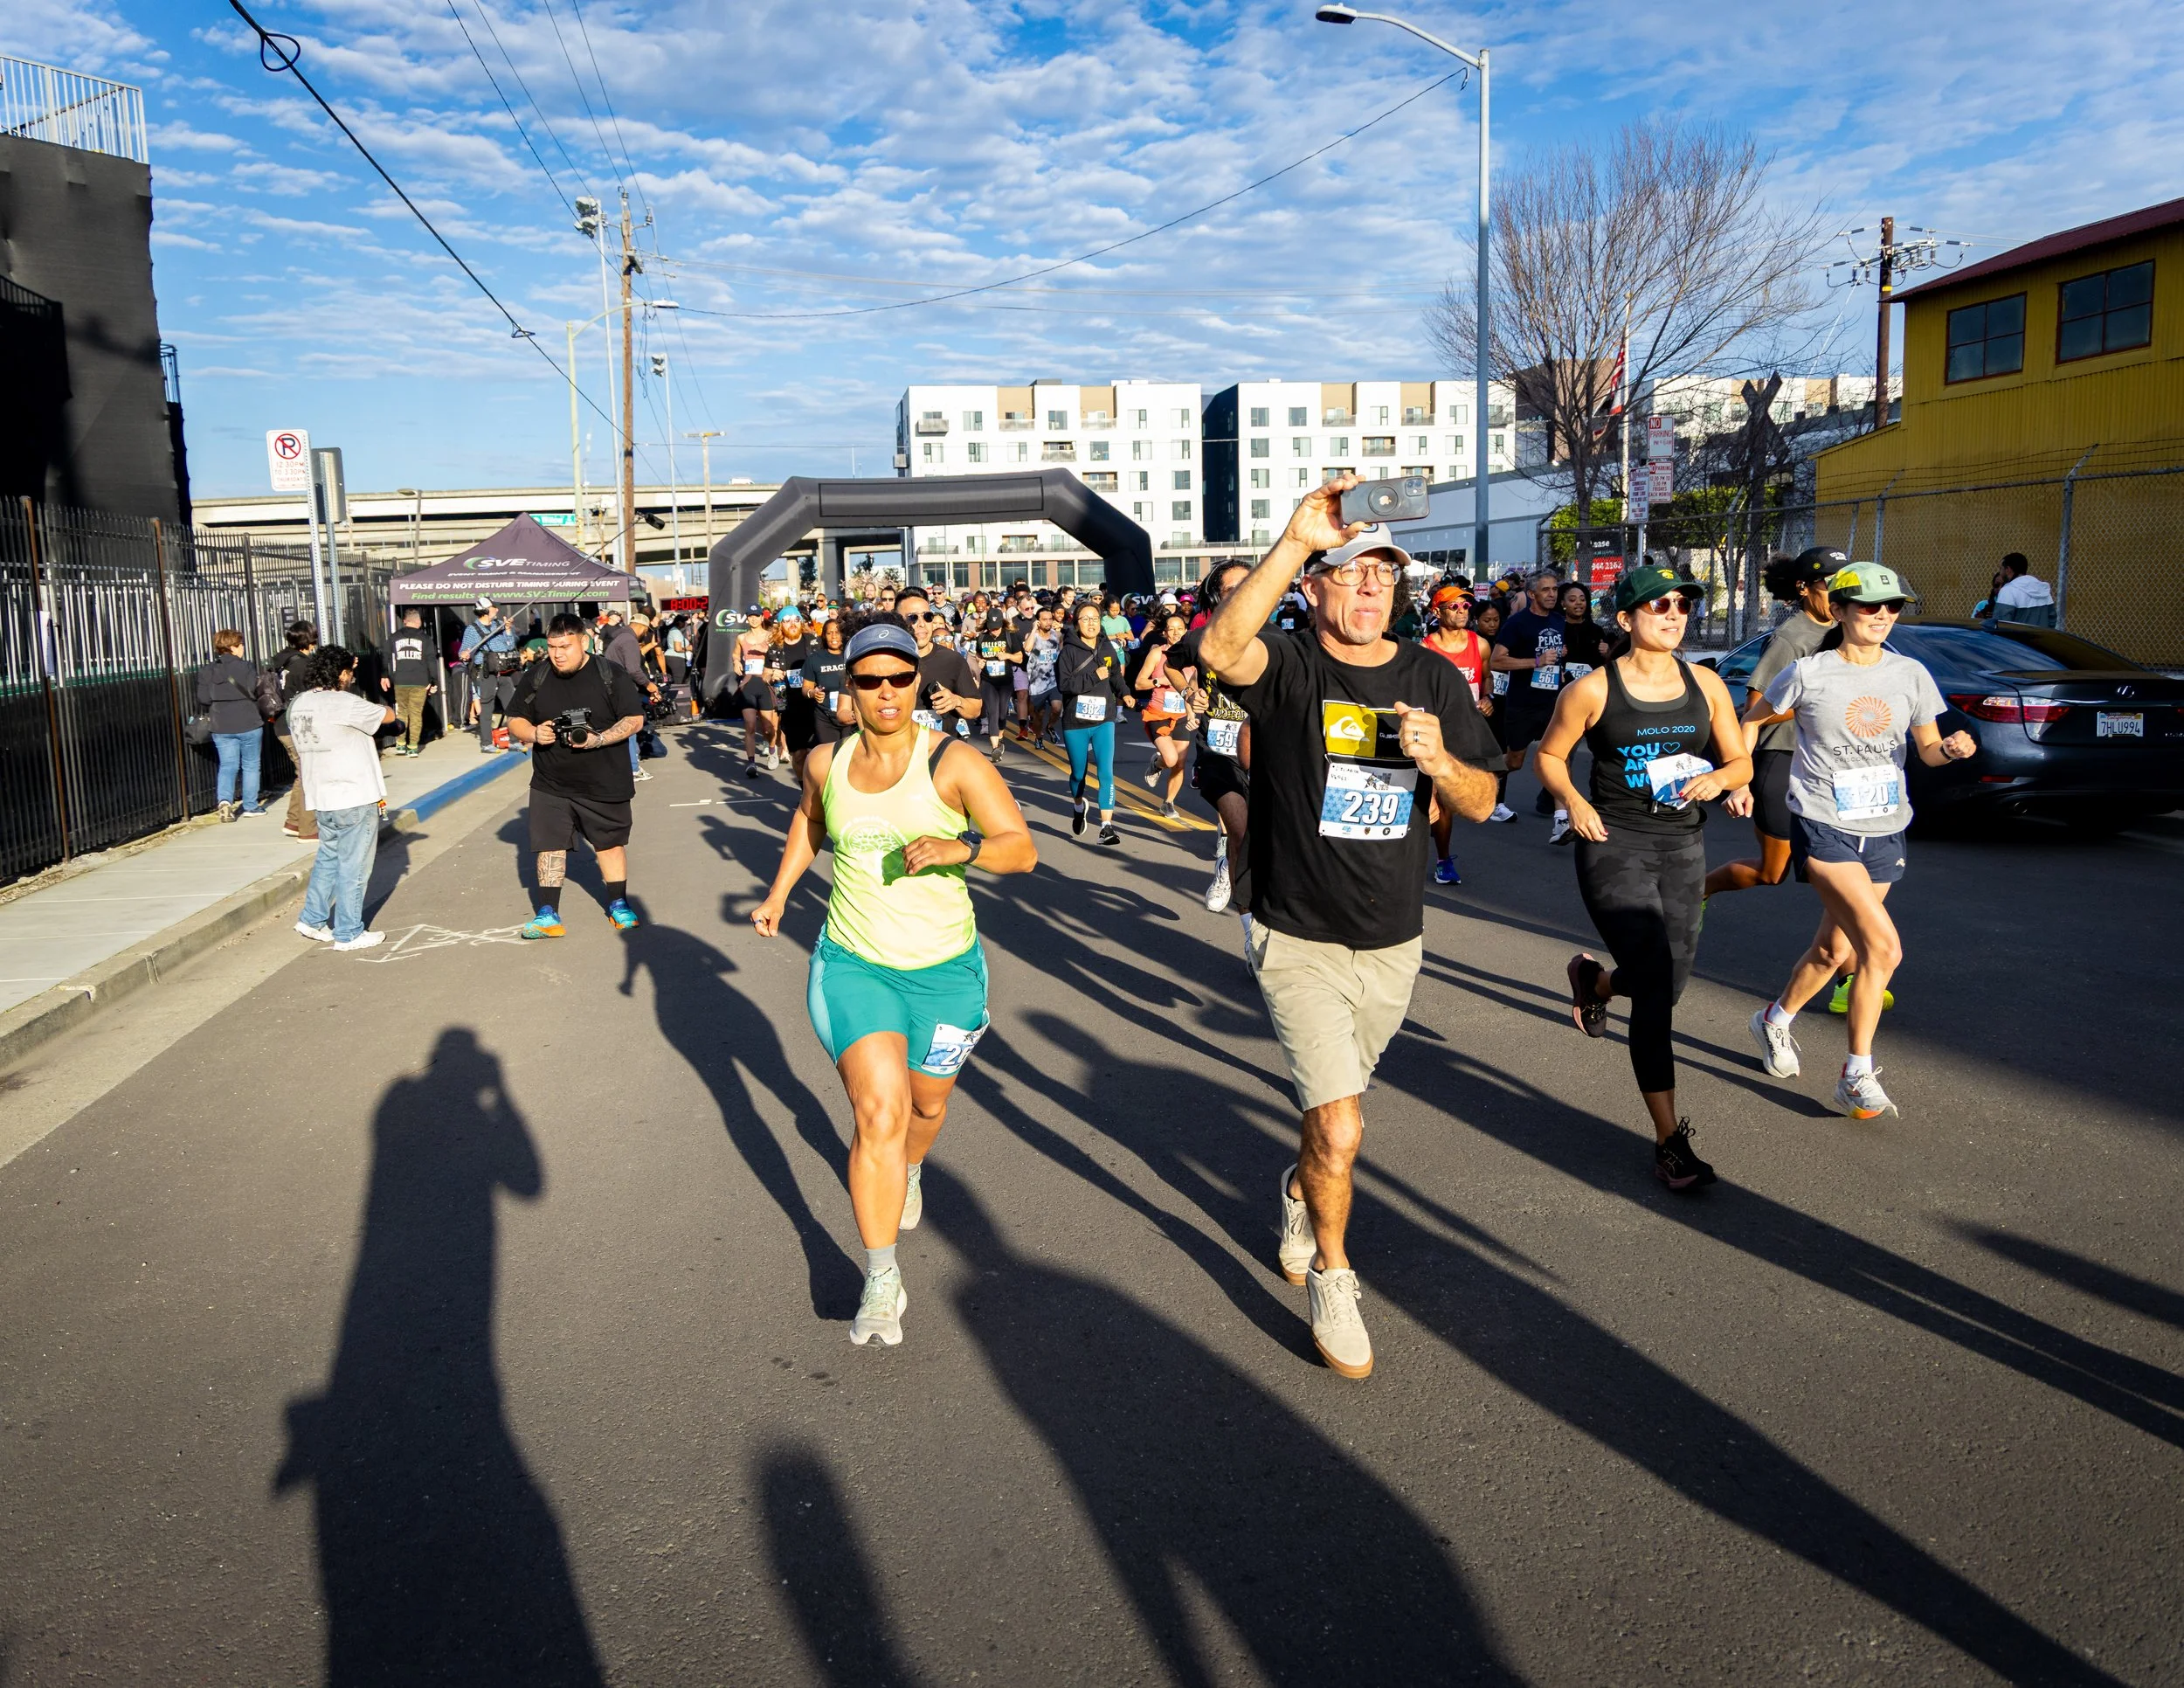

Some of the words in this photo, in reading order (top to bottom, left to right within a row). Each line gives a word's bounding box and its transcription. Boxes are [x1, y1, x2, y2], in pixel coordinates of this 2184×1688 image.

[1650, 419, 1661, 428] NO
[724, 613, 750, 623] SV
[1538, 633, 1563, 647] PEACE
[820, 663, 846, 673] ERAC
[1538, 672, 1555, 684] 561
[1082, 703, 1102, 715] 382
[1637, 726, 1669, 737] MOLO
[2100, 721, 2140, 734] 7HLU994
[1616, 742, 1660, 758] YOU
[1833, 744, 1853, 757] ST.
[1850, 783, 1890, 808] 120
[1340, 791, 1400, 825] 239
